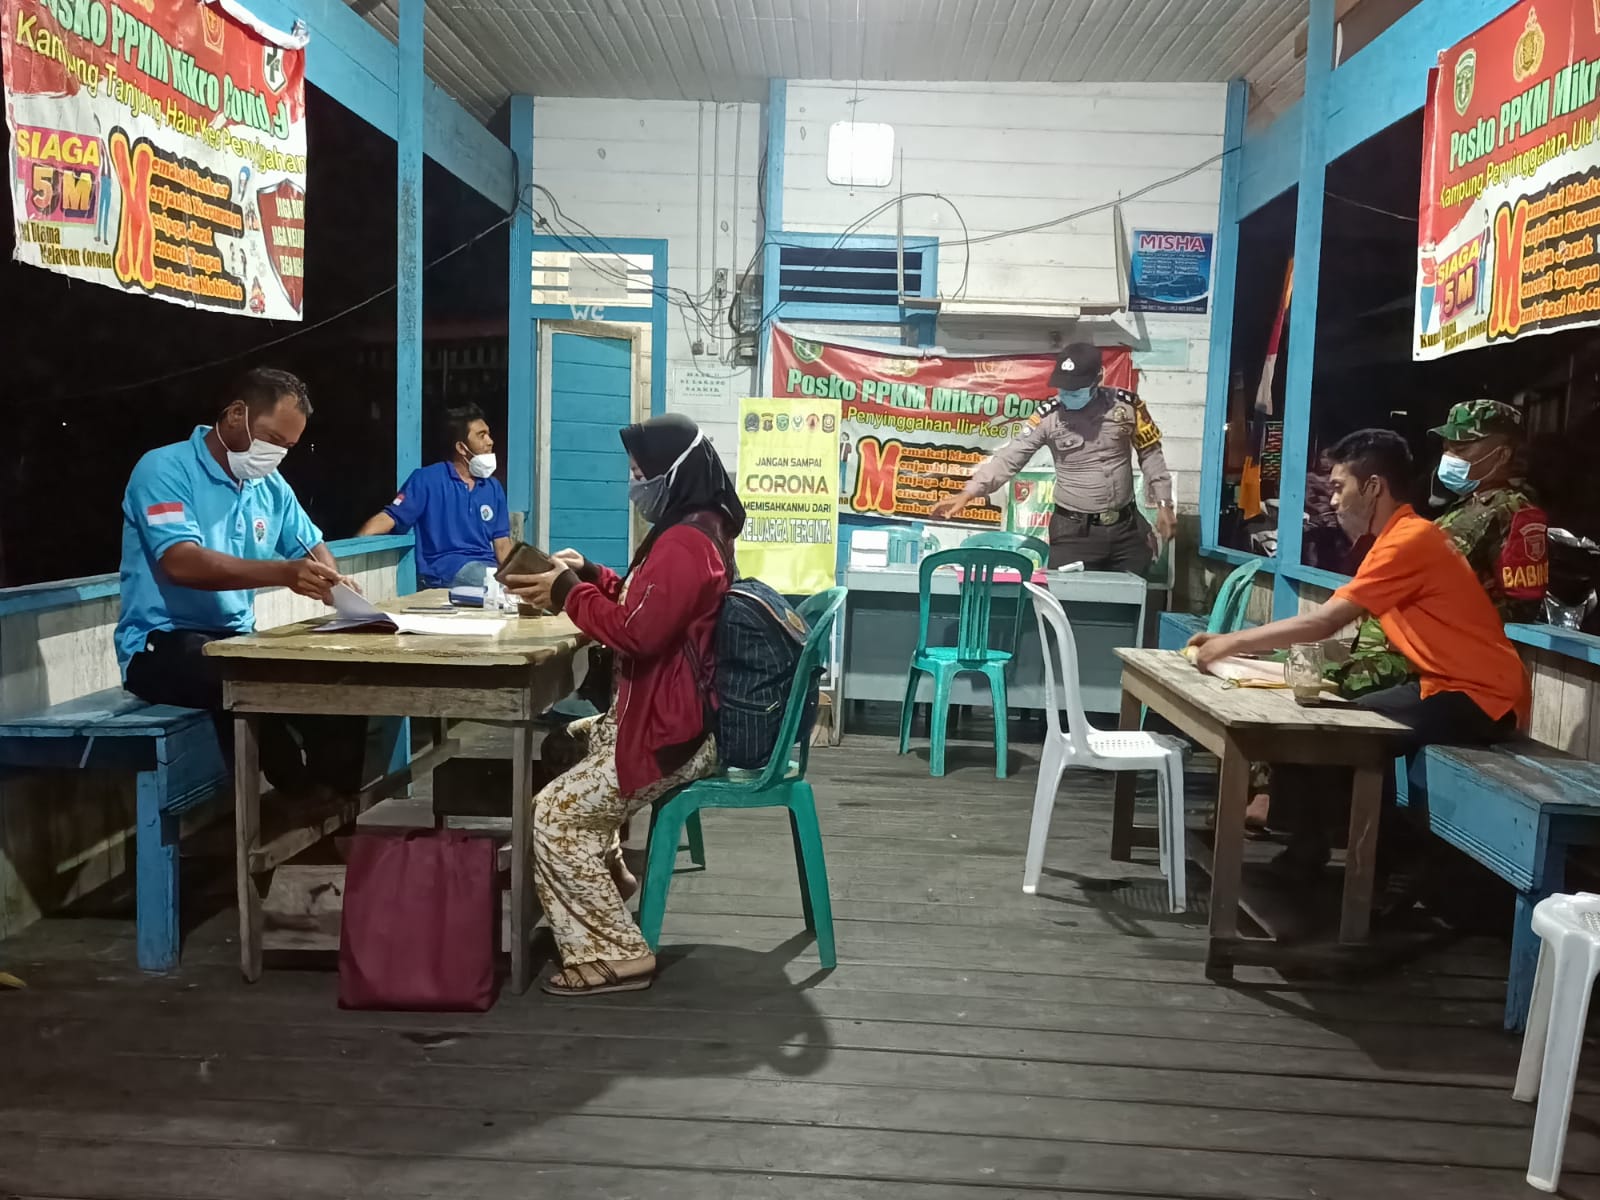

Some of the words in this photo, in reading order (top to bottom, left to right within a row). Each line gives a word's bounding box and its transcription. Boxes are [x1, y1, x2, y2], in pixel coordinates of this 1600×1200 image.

[110, 3, 169, 84] PPKM
[167, 44, 219, 113] Mikro
[104, 62, 163, 129] Tanjung
[166, 96, 198, 138] Haur
[1450, 117, 1497, 173] Posko
[1498, 77, 1551, 148] PPKM
[1551, 57, 1600, 120] Mikr
[1571, 115, 1595, 151] Ulu
[16, 128, 100, 167] SIAGA
[1140, 234, 1206, 253] MISHA
[1437, 238, 1480, 286] SIAGA
[1554, 263, 1600, 292] Tangan
[569, 304, 605, 321] WC
[786, 368, 857, 401] Posko
[861, 379, 927, 410] PPKM
[930, 386, 999, 417] Mikro
[847, 406, 951, 433] Penyinggahan
[955, 418, 976, 435] Ilir
[979, 421, 1008, 438] Kec
[1011, 422, 1023, 438] P
[755, 457, 790, 468] JANGAN
[790, 457, 823, 468] SAMPAI
[899, 460, 948, 475] enjauhi
[901, 446, 948, 462] emakai
[745, 474, 830, 495] CORONA
[895, 487, 937, 501] encuci
[898, 475, 938, 490] enjaga
[743, 501, 811, 513] MEMISAHKANMU
[811, 503, 832, 513] DARI
[790, 517, 833, 544] TERCINTA
[1502, 561, 1549, 588] BABIN
